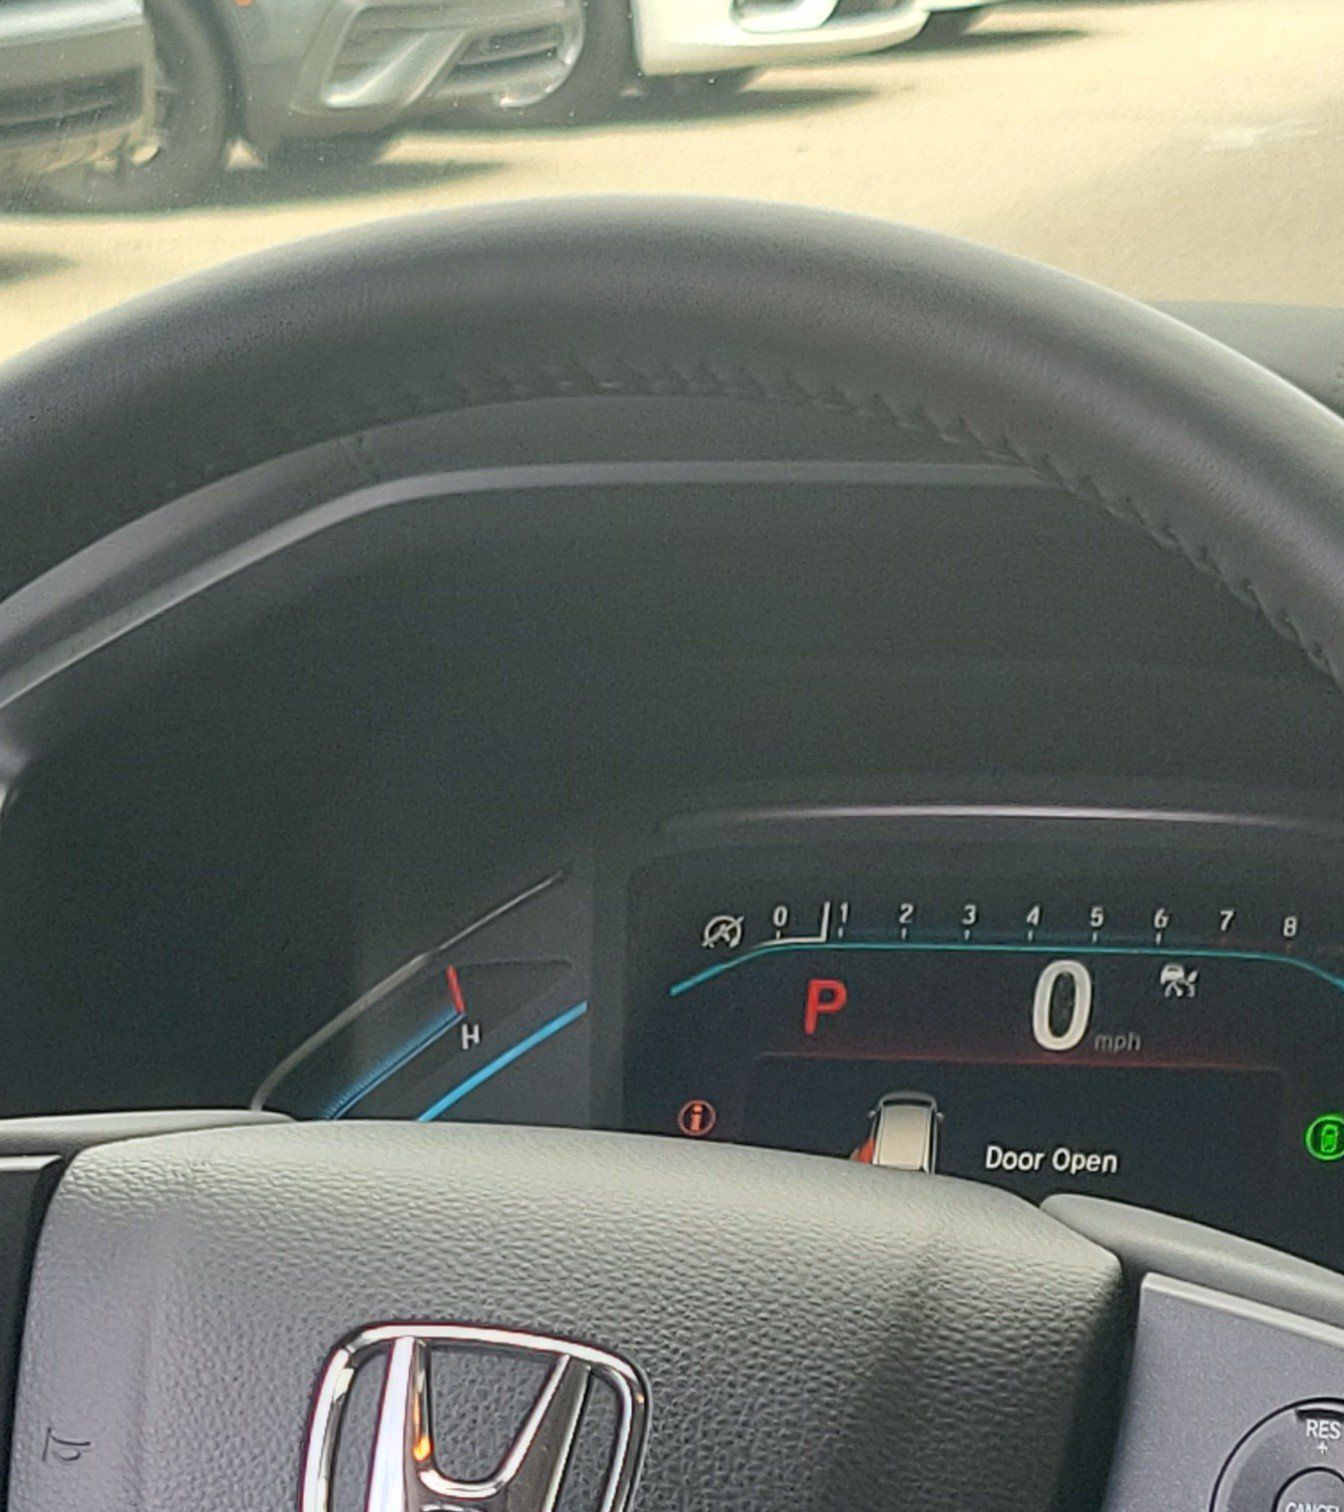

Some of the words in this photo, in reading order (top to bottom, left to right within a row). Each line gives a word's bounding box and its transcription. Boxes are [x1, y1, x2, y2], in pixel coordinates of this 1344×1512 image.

[773, 905, 788, 927] 0
[839, 902, 849, 924] 1
[899, 903, 914, 924] 2
[961, 904, 977, 926] 3
[1026, 905, 1040, 926] 4
[1090, 906, 1104, 928] 5
[1154, 907, 1169, 928] 6
[1220, 910, 1235, 932] 7
[1283, 915, 1298, 938] 8
[804, 978, 847, 1036] P
[1032, 959, 1093, 1051] 0
[1093, 1031, 1142, 1053] mph
[462, 1023, 479, 1050] H
[985, 1145, 1045, 1171] Door
[1052, 1147, 1118, 1175] Open
[1306, 1418, 1342, 1440] RES
